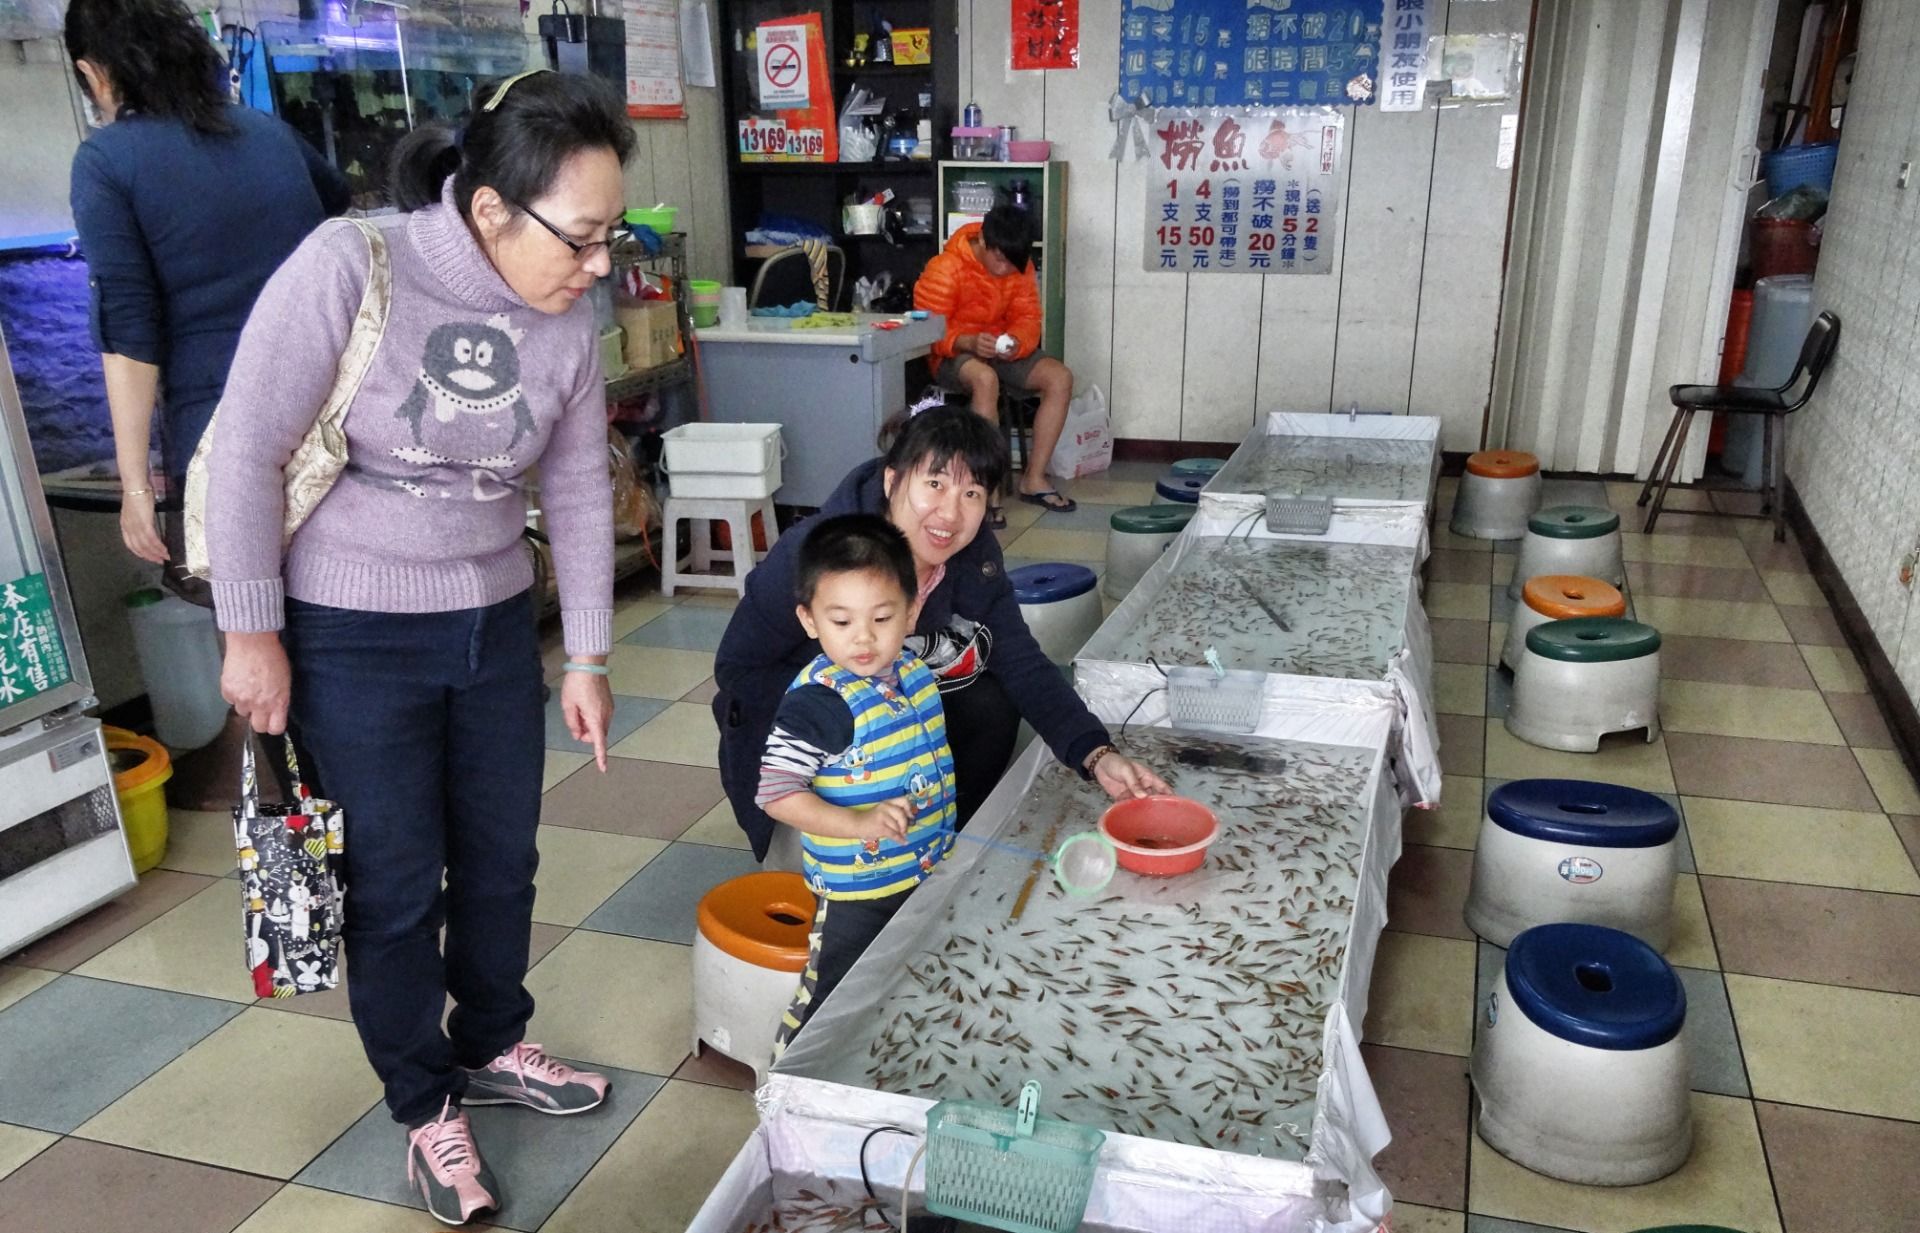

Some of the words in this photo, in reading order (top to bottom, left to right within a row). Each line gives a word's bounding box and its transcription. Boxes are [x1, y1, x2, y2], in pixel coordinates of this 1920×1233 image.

[742, 128, 786, 151] 13169
[789, 136, 824, 153] 13169
[1157, 117, 1250, 173] 撈魚
[2, 583, 49, 692] 本店有售
